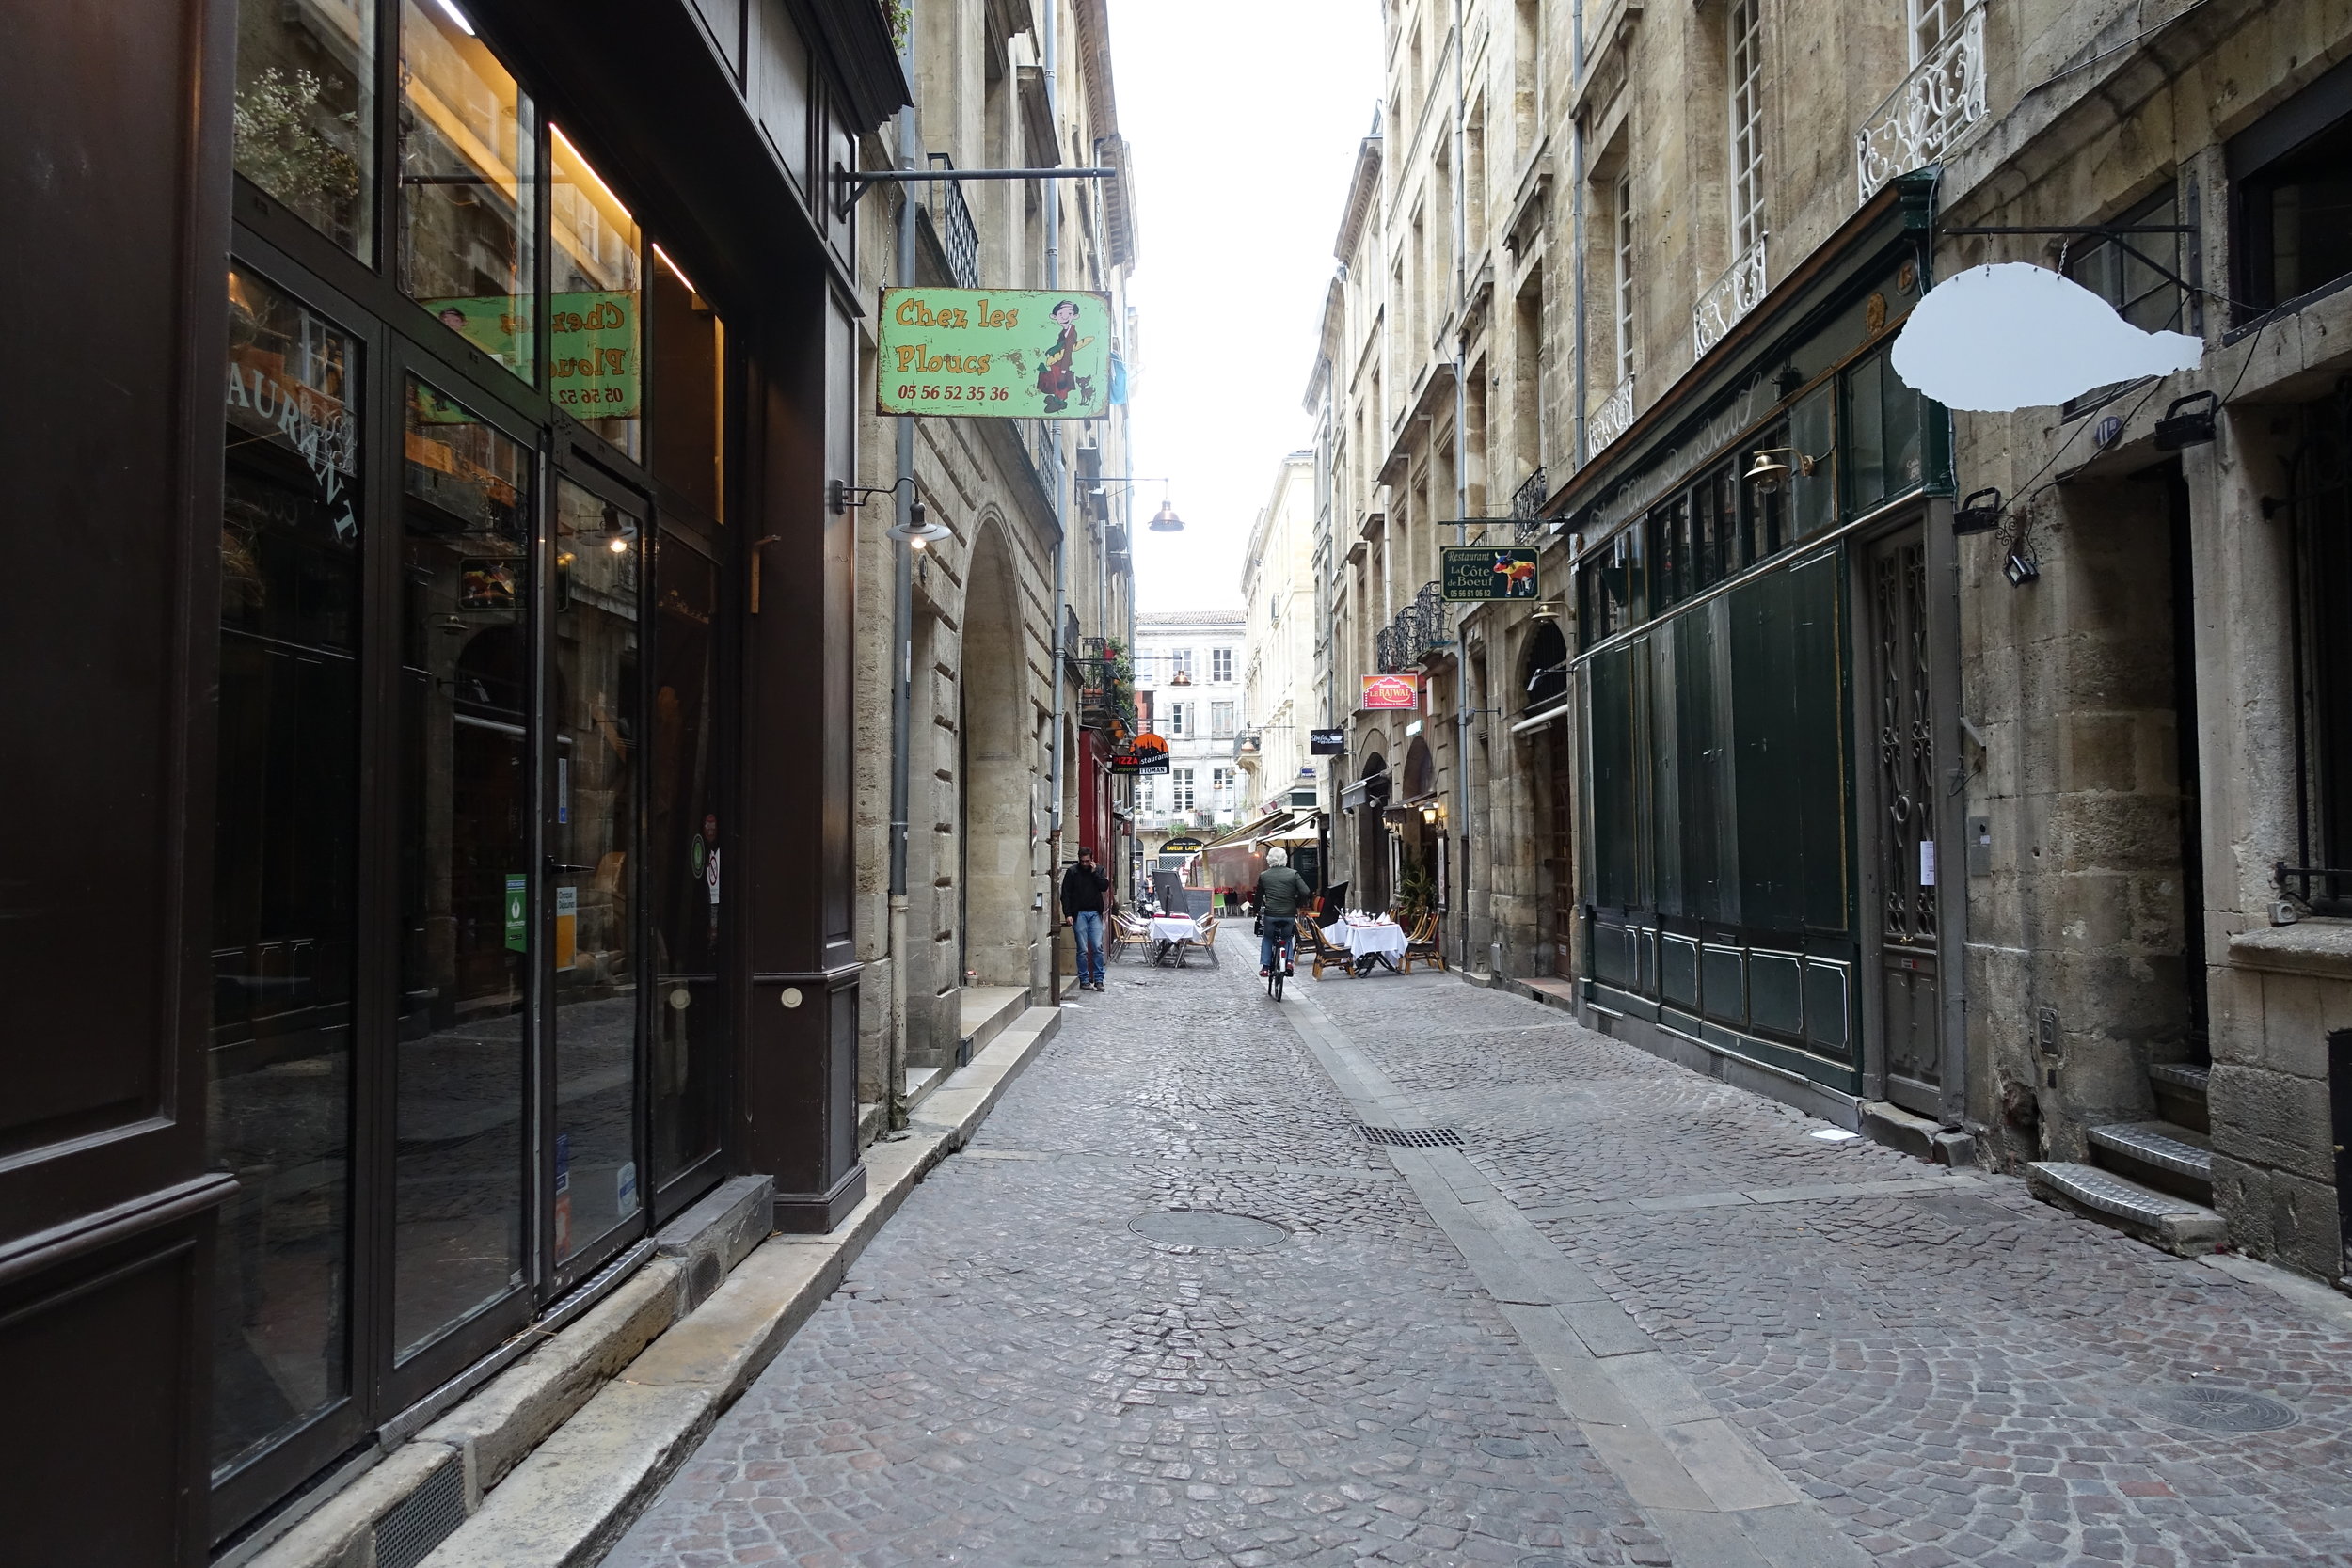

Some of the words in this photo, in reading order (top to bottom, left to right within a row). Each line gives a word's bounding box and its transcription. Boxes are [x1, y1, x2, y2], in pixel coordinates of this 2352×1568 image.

[896, 298, 968, 329] Chez
[977, 299, 1019, 330] les
[897, 344, 991, 376] Ploucs
[898, 384, 917, 400] 05
[921, 385, 940, 400] 56
[944, 385, 962, 400] 52
[967, 386, 986, 401] 35
[990, 386, 1009, 401] 36
[1448, 551, 1490, 562] Restaurant
[1460, 564, 1490, 577] Côte
[1457, 575, 1494, 587] Boeuf
[1450, 589, 1457, 597] 05
[1458, 589, 1466, 597] 56
[1467, 589, 1474, 597] 51
[1475, 589, 1483, 597] 05
[1484, 589, 1491, 597] 52
[1113, 756, 1138, 765] PIZZA
